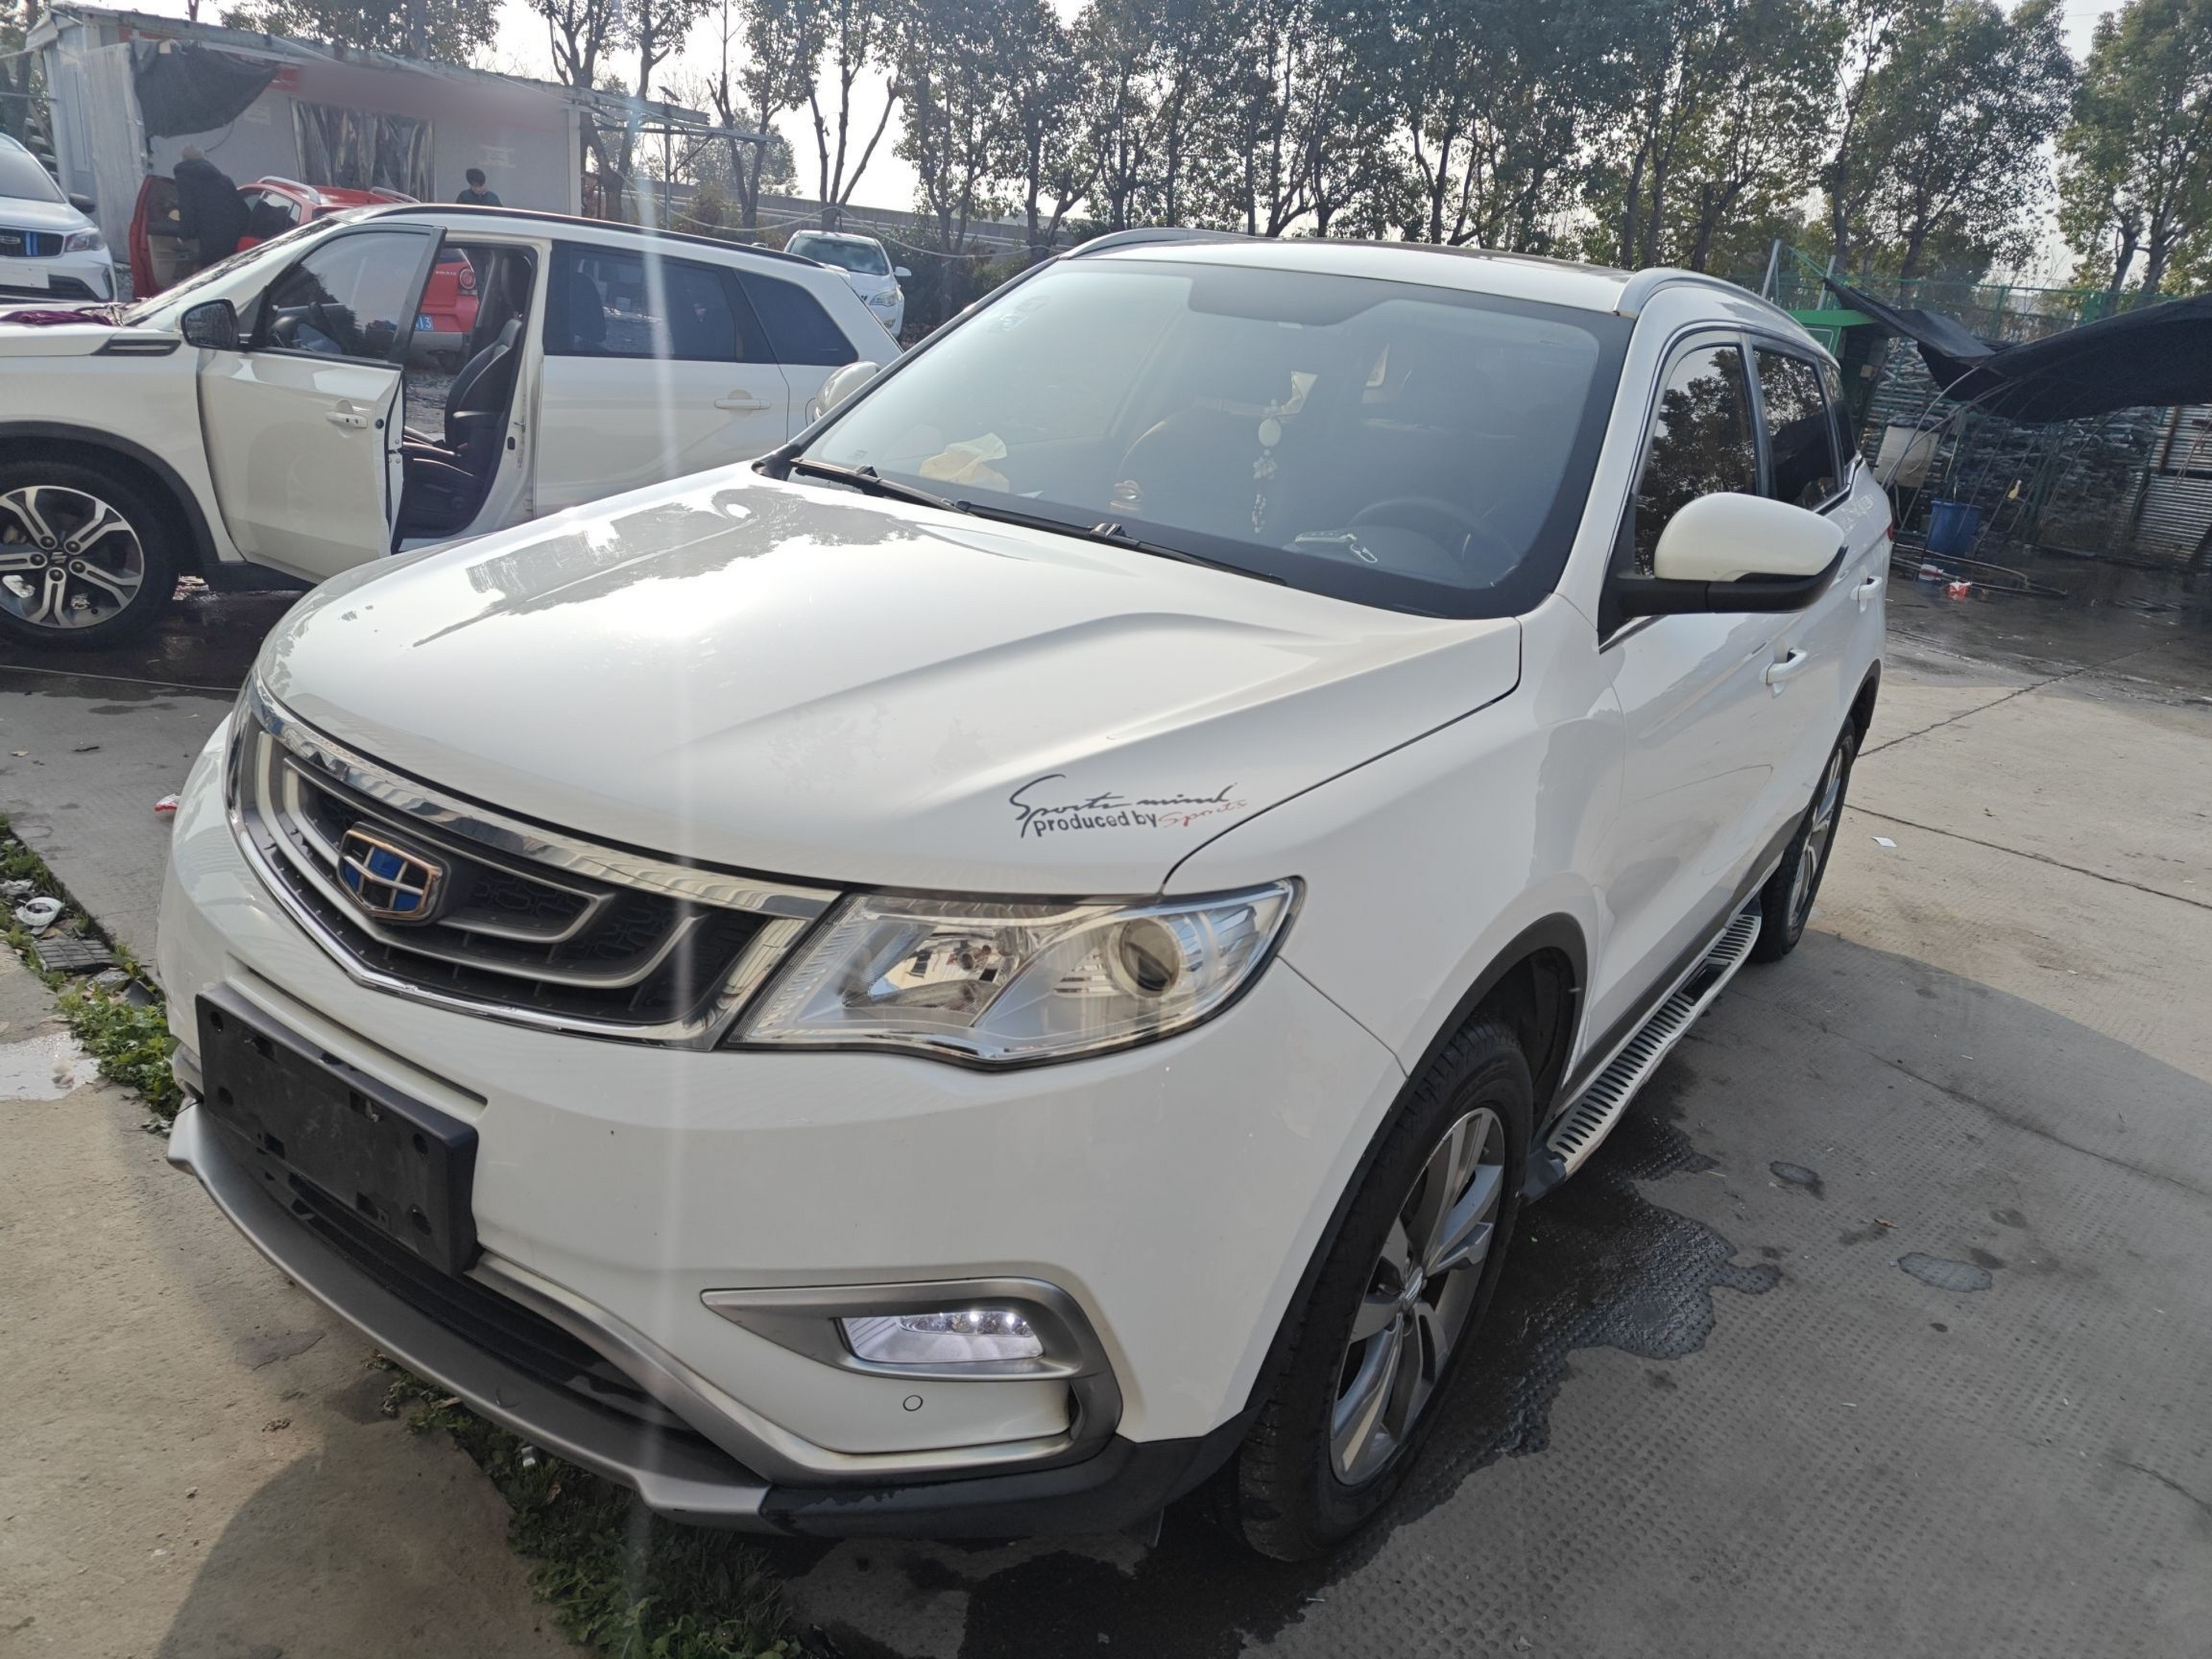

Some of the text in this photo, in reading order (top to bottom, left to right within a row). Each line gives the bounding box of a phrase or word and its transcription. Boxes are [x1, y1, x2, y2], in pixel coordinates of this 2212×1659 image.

[1137, 782, 1237, 805] mind
[1033, 812, 1130, 837] produced
[1131, 810, 1157, 828] by
